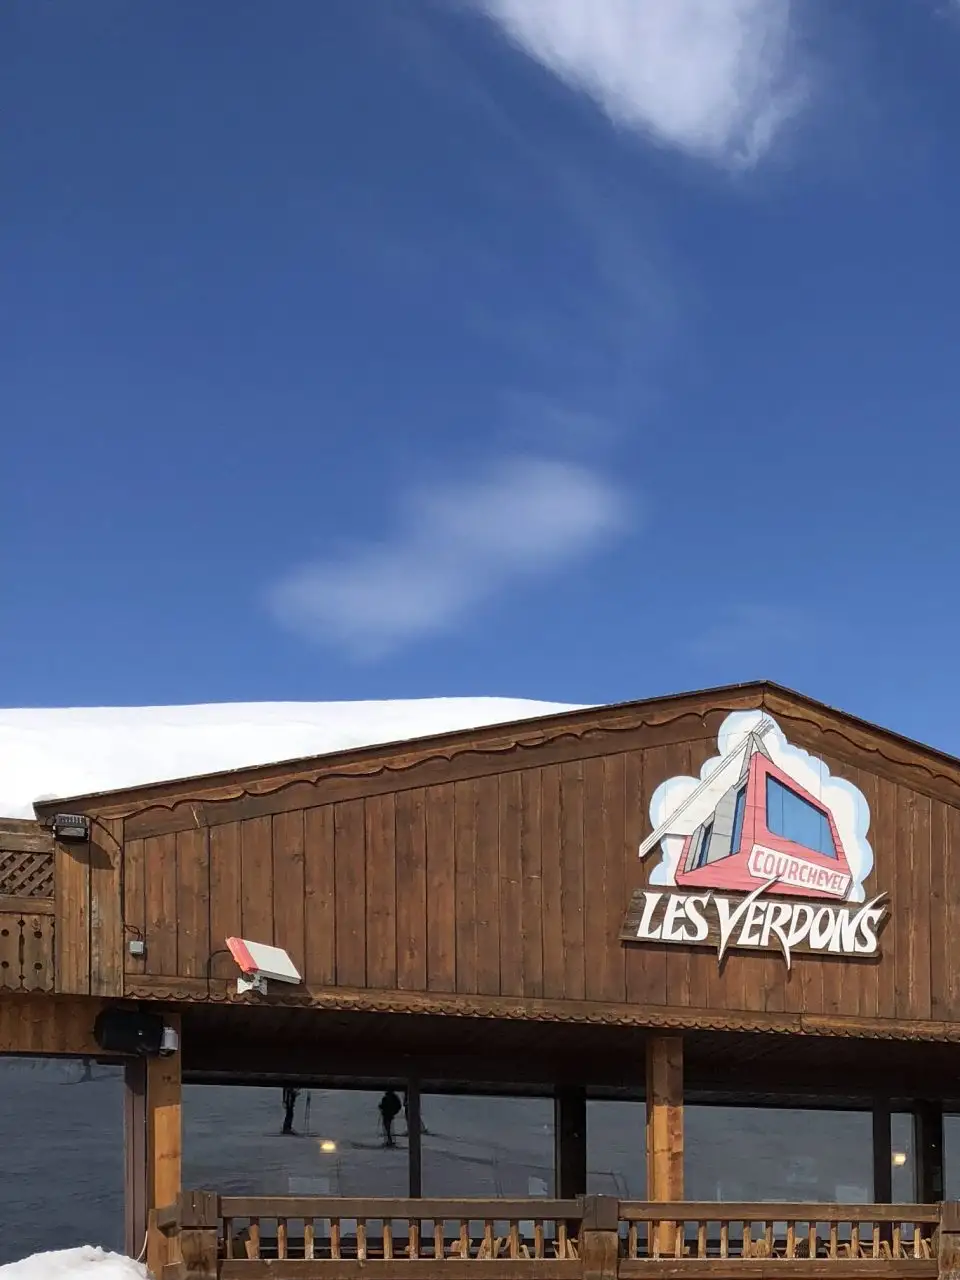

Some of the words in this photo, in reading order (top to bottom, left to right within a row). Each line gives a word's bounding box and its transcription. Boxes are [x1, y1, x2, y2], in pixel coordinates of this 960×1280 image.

[752, 850, 844, 890] COURCHEVEL
[636, 890, 711, 941] LES
[713, 875, 889, 971] VERDONS
